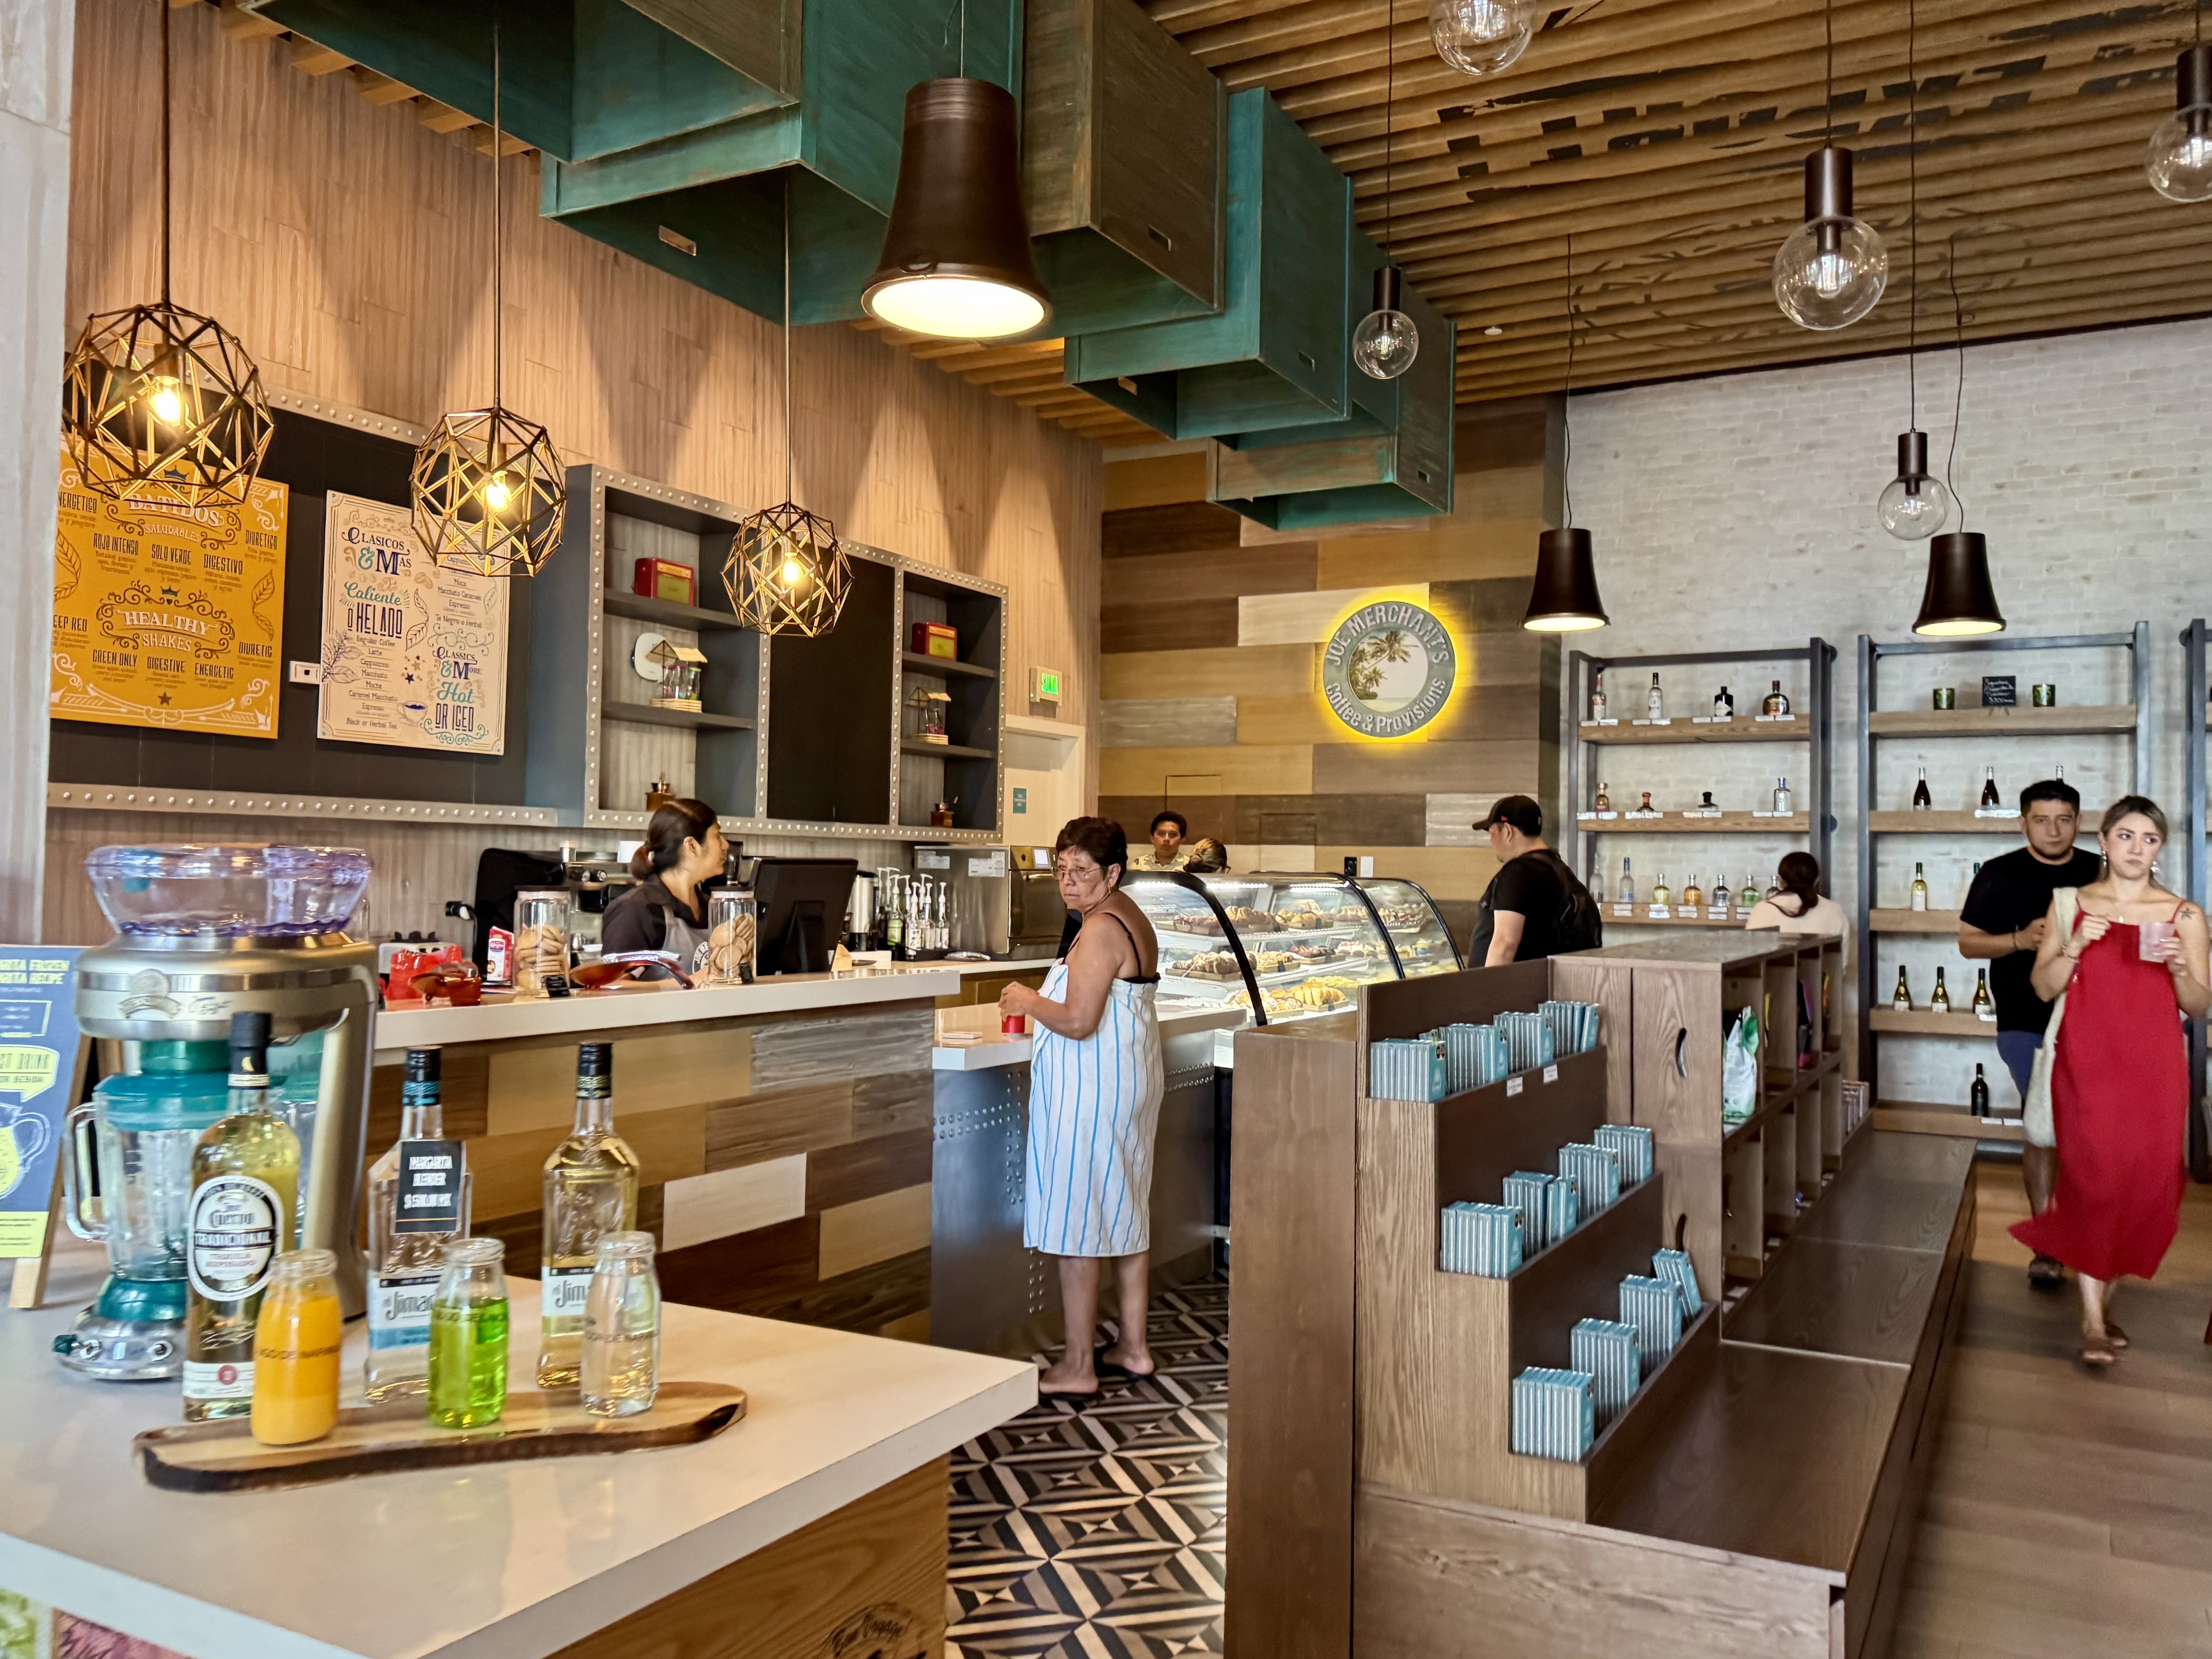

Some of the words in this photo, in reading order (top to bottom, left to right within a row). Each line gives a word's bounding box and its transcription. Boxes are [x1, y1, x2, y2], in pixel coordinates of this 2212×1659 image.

[129, 493, 222, 527] BATIDOS
[145, 524, 199, 542] SALUDABLES
[245, 530, 277, 550] DIURETICO
[341, 527, 404, 550] CLASICOS
[93, 533, 110, 550] ROJO
[112, 537, 139, 555] INTENSO
[152, 544, 168, 561] SOLO
[171, 547, 191, 565] VERDE
[204, 554, 243, 575] DIGESTIVO
[358, 547, 375, 570] &
[375, 549, 411, 575] MAS
[344, 582, 402, 605] Caliente
[72, 617, 87, 632] RED
[120, 610, 214, 635] HEALTHY
[357, 602, 402, 638] HELADO
[142, 633, 192, 652] SHAKES
[1326, 631, 1351, 666] JOE
[1346, 605, 1449, 664] MERCHANT'S
[93, 649, 117, 664] GREEN
[119, 653, 137, 667] ONLY
[239, 642, 273, 658] DIURETIC
[432, 647, 476, 661] CLASSICS
[147, 656, 185, 673] DIGESTIVE
[195, 662, 234, 679] ENERGETIC
[441, 660, 452, 677] &
[437, 681, 474, 703] Hot
[1326, 683, 1362, 726] Coffee
[1362, 714, 1373, 732] &
[1376, 677, 1446, 733] Provisions
[435, 703, 448, 729] OR
[452, 704, 474, 732] ICED
